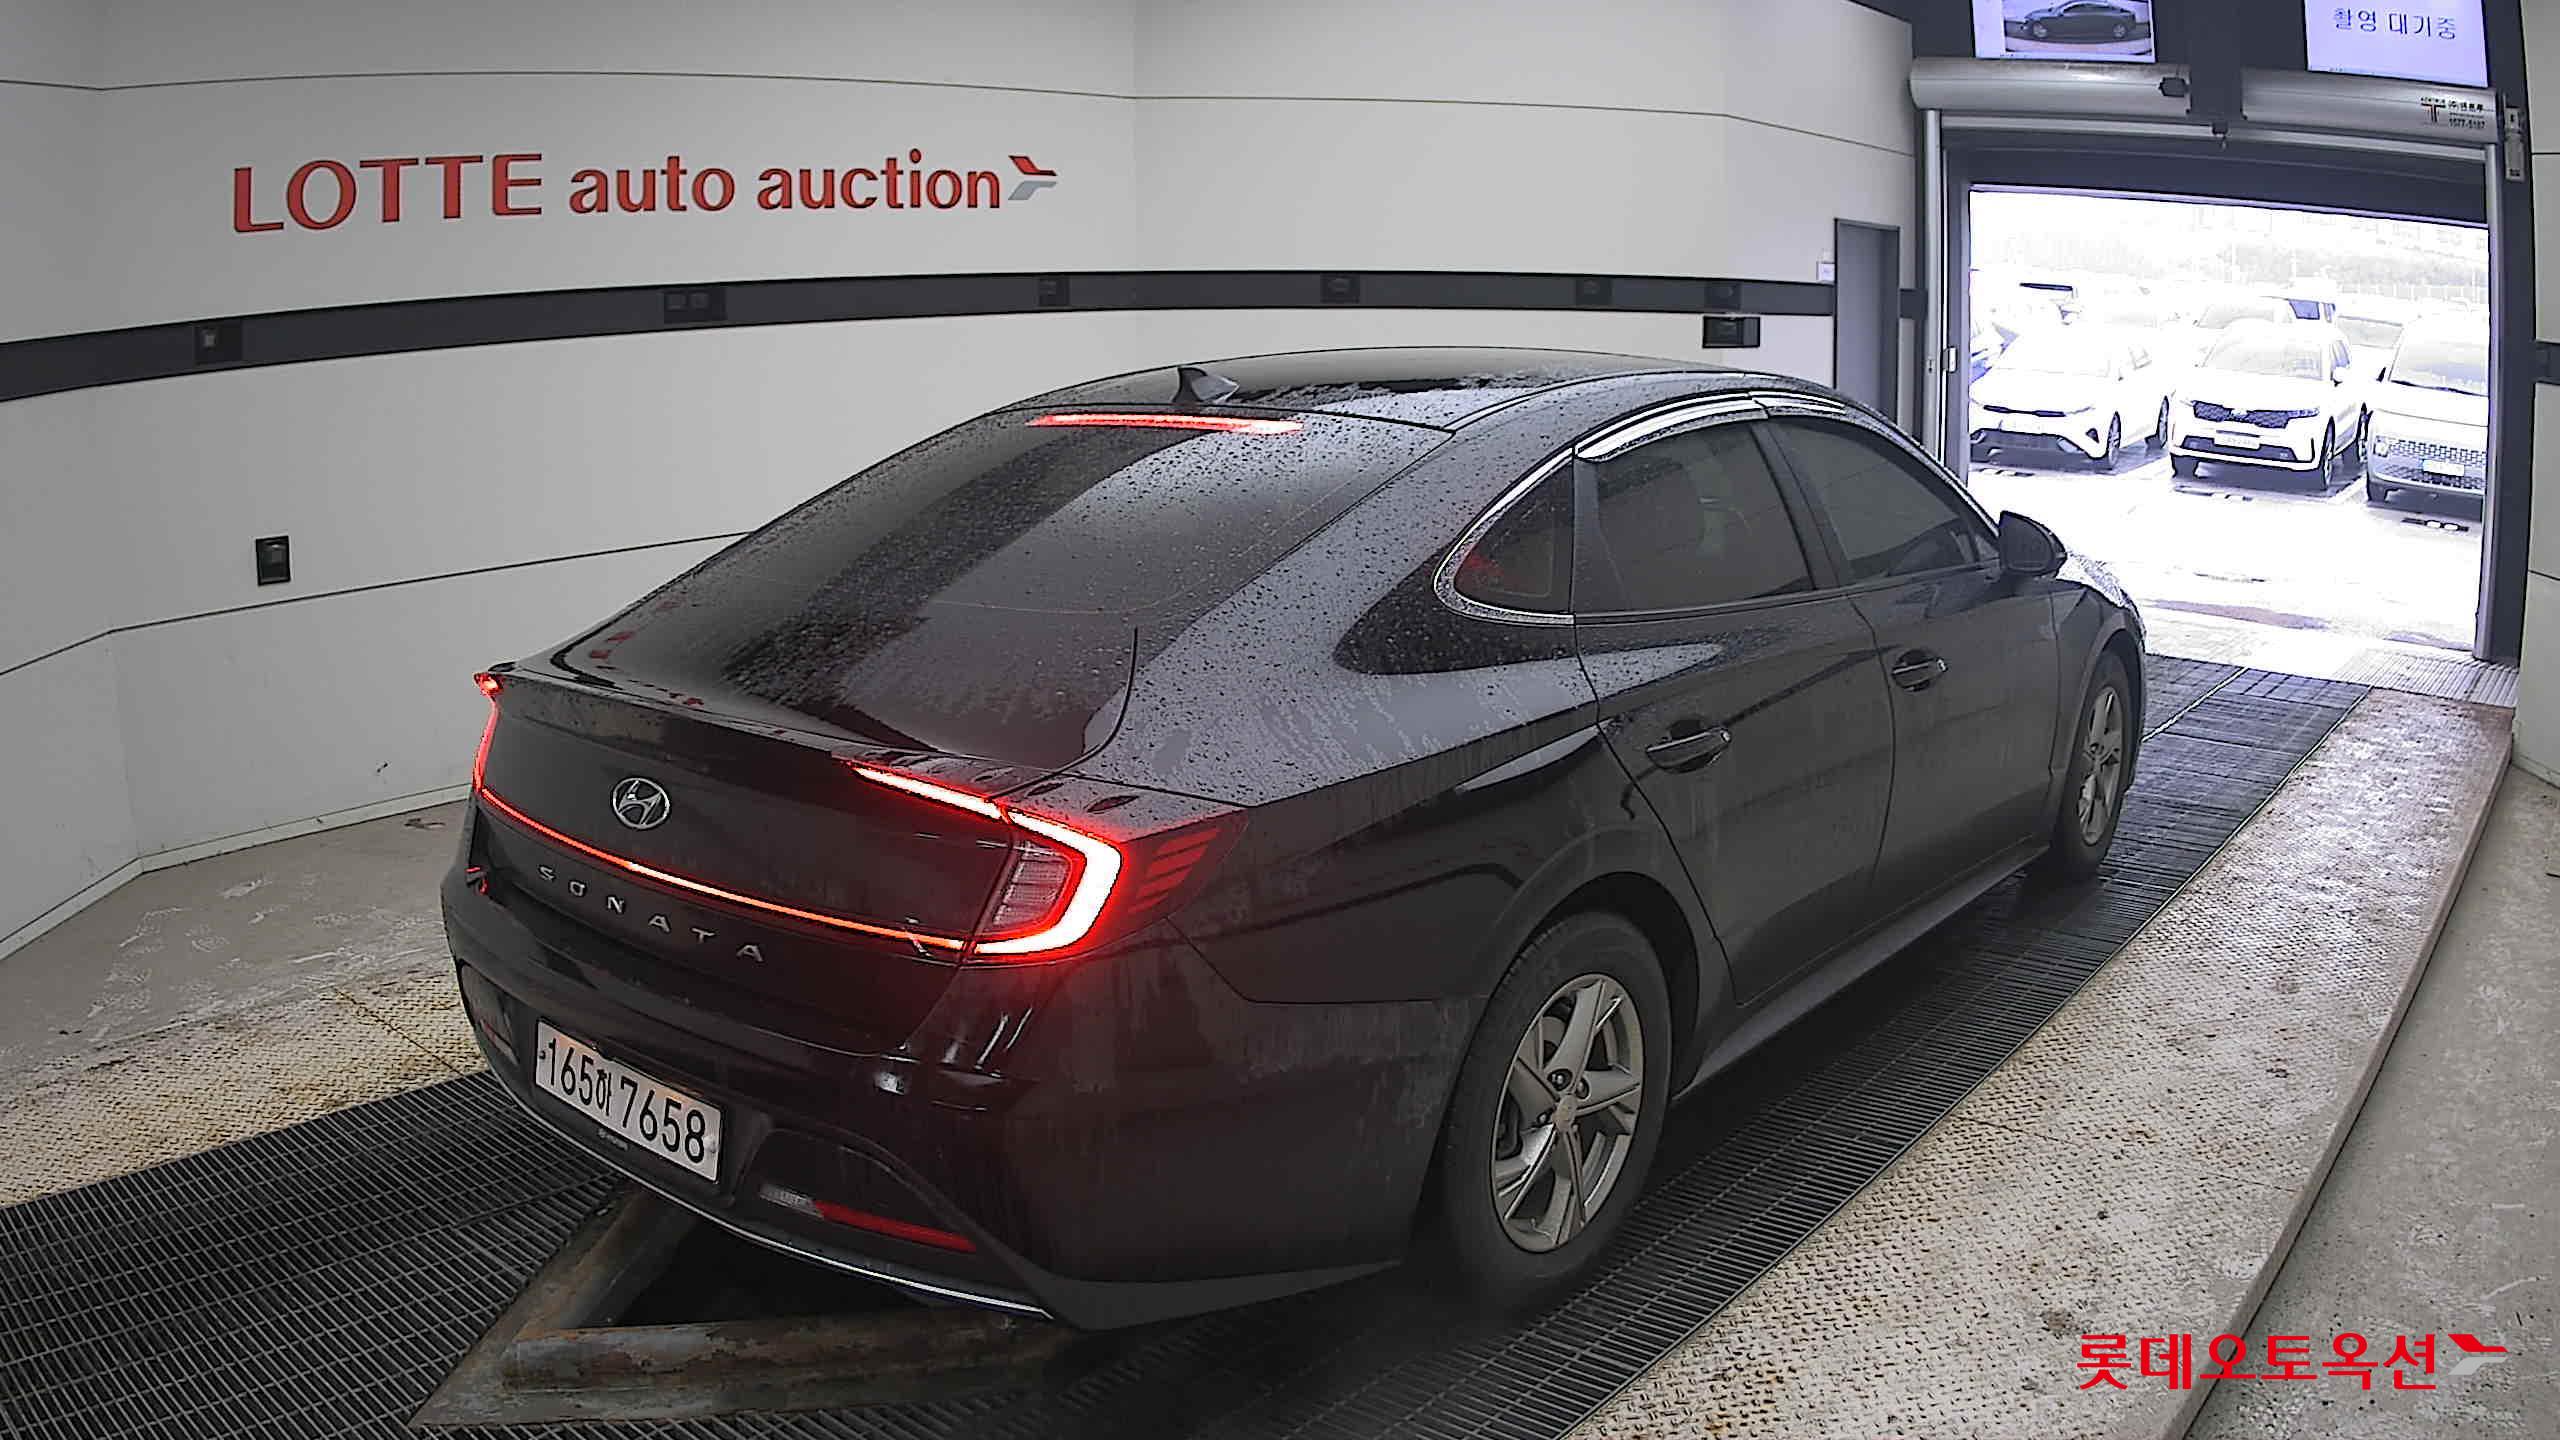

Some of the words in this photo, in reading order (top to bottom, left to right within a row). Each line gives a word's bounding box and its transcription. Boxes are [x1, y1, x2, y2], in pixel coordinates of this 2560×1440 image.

[2334, 8, 2377, 33] 촬영
[2388, 13, 2456, 40] 대기중
[233, 153, 542, 233] LOTTE
[568, 155, 736, 215] auto
[756, 148, 1002, 210] auction
[538, 865, 764, 962] SONATA
[548, 1037, 613, 1117] 165하
[619, 1076, 707, 1164] 7658
